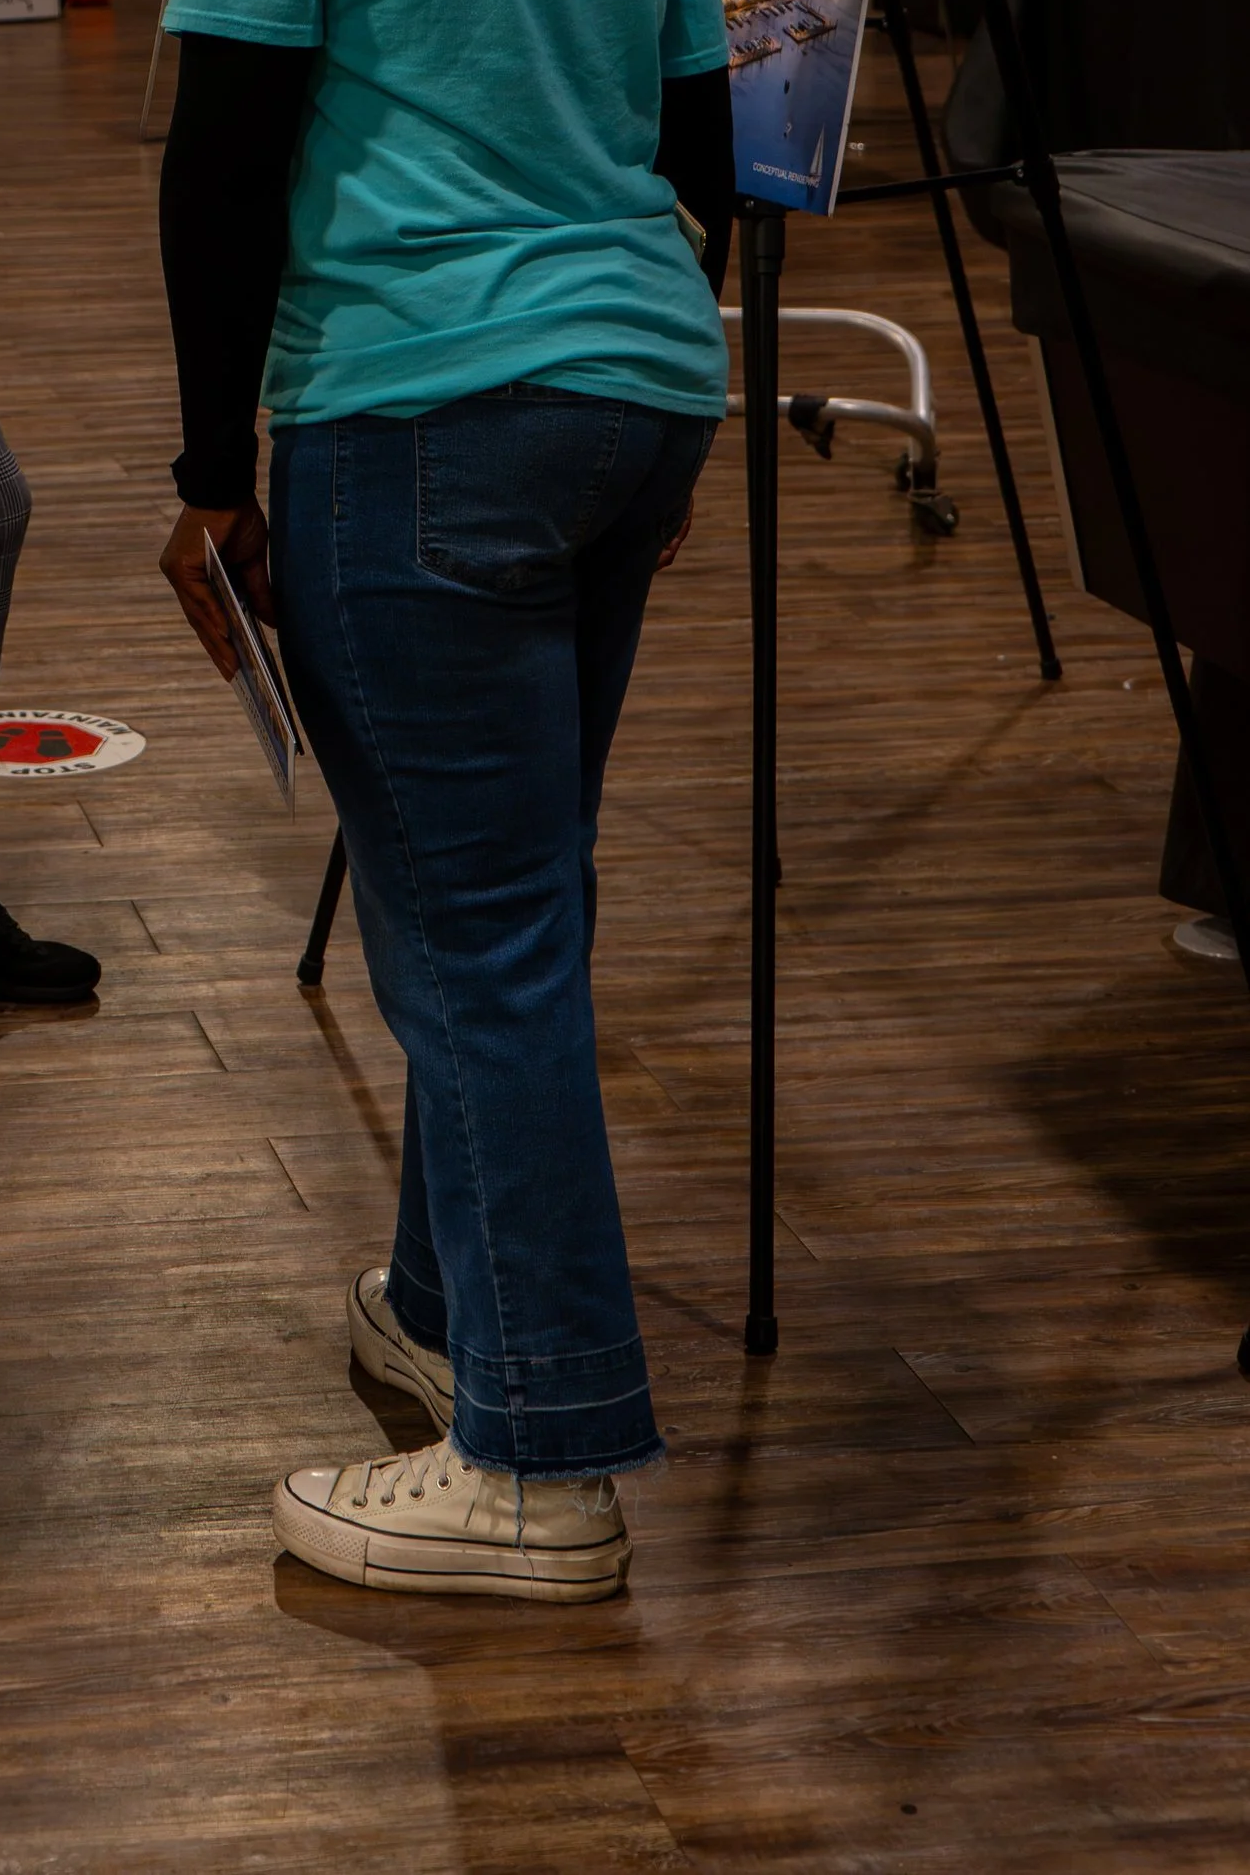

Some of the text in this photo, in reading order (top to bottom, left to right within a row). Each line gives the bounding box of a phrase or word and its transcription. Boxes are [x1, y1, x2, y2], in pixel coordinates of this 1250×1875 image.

[752, 162, 821, 189] CONCEPTUAL RENDERING
[10, 762, 96, 775] STOP
